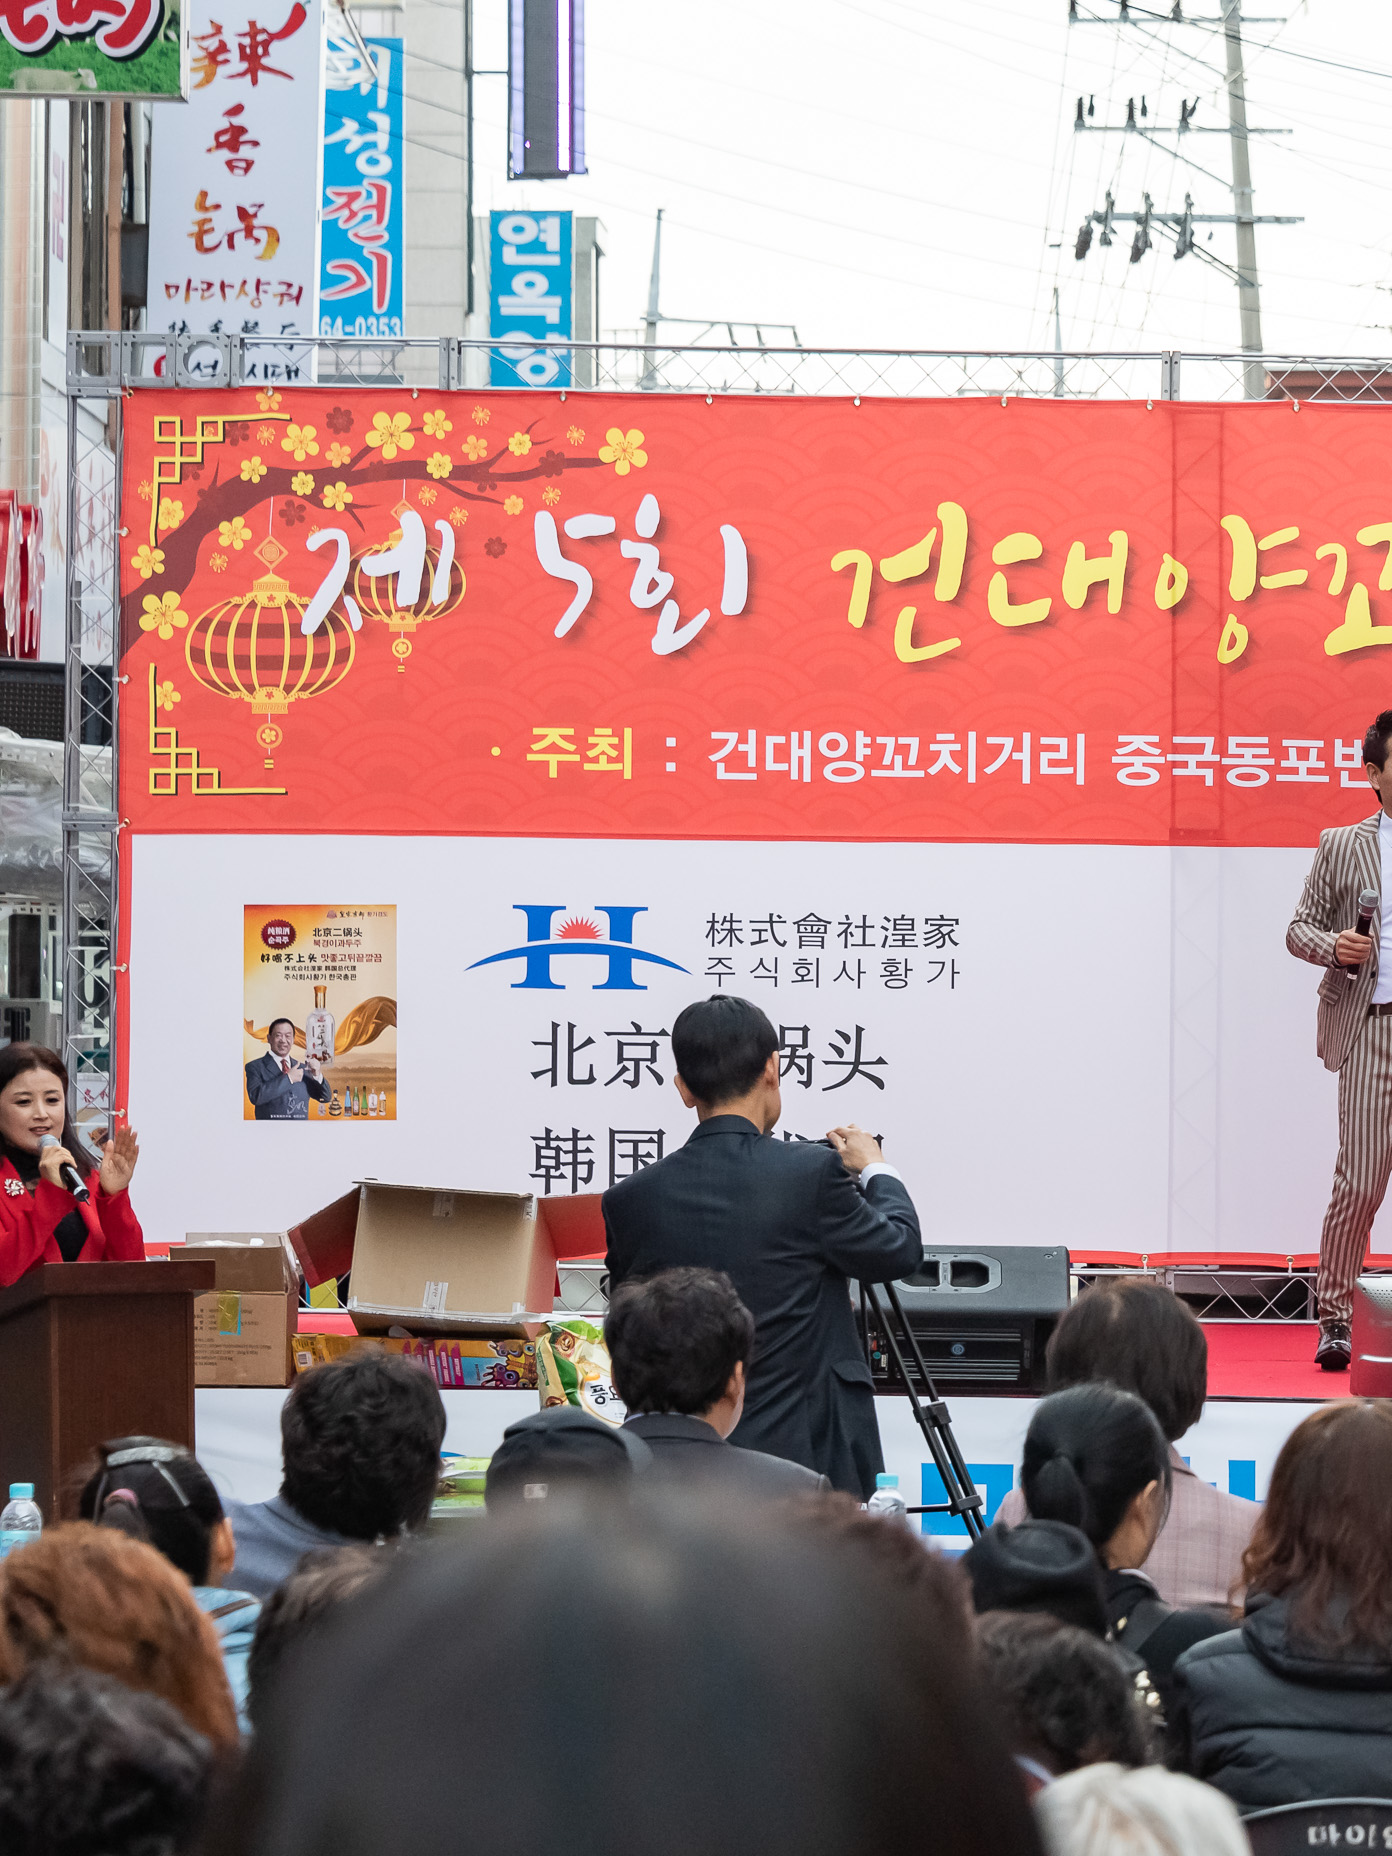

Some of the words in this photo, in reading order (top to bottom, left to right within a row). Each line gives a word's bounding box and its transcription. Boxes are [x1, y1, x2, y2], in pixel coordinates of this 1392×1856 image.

[301, 511, 455, 635] 제
[535, 494, 748, 655] 5회
[526, 727, 632, 780] 주최
[708, 729, 1086, 787] 건대양꼬치거리
[312, 927, 363, 938] 北京二锅头
